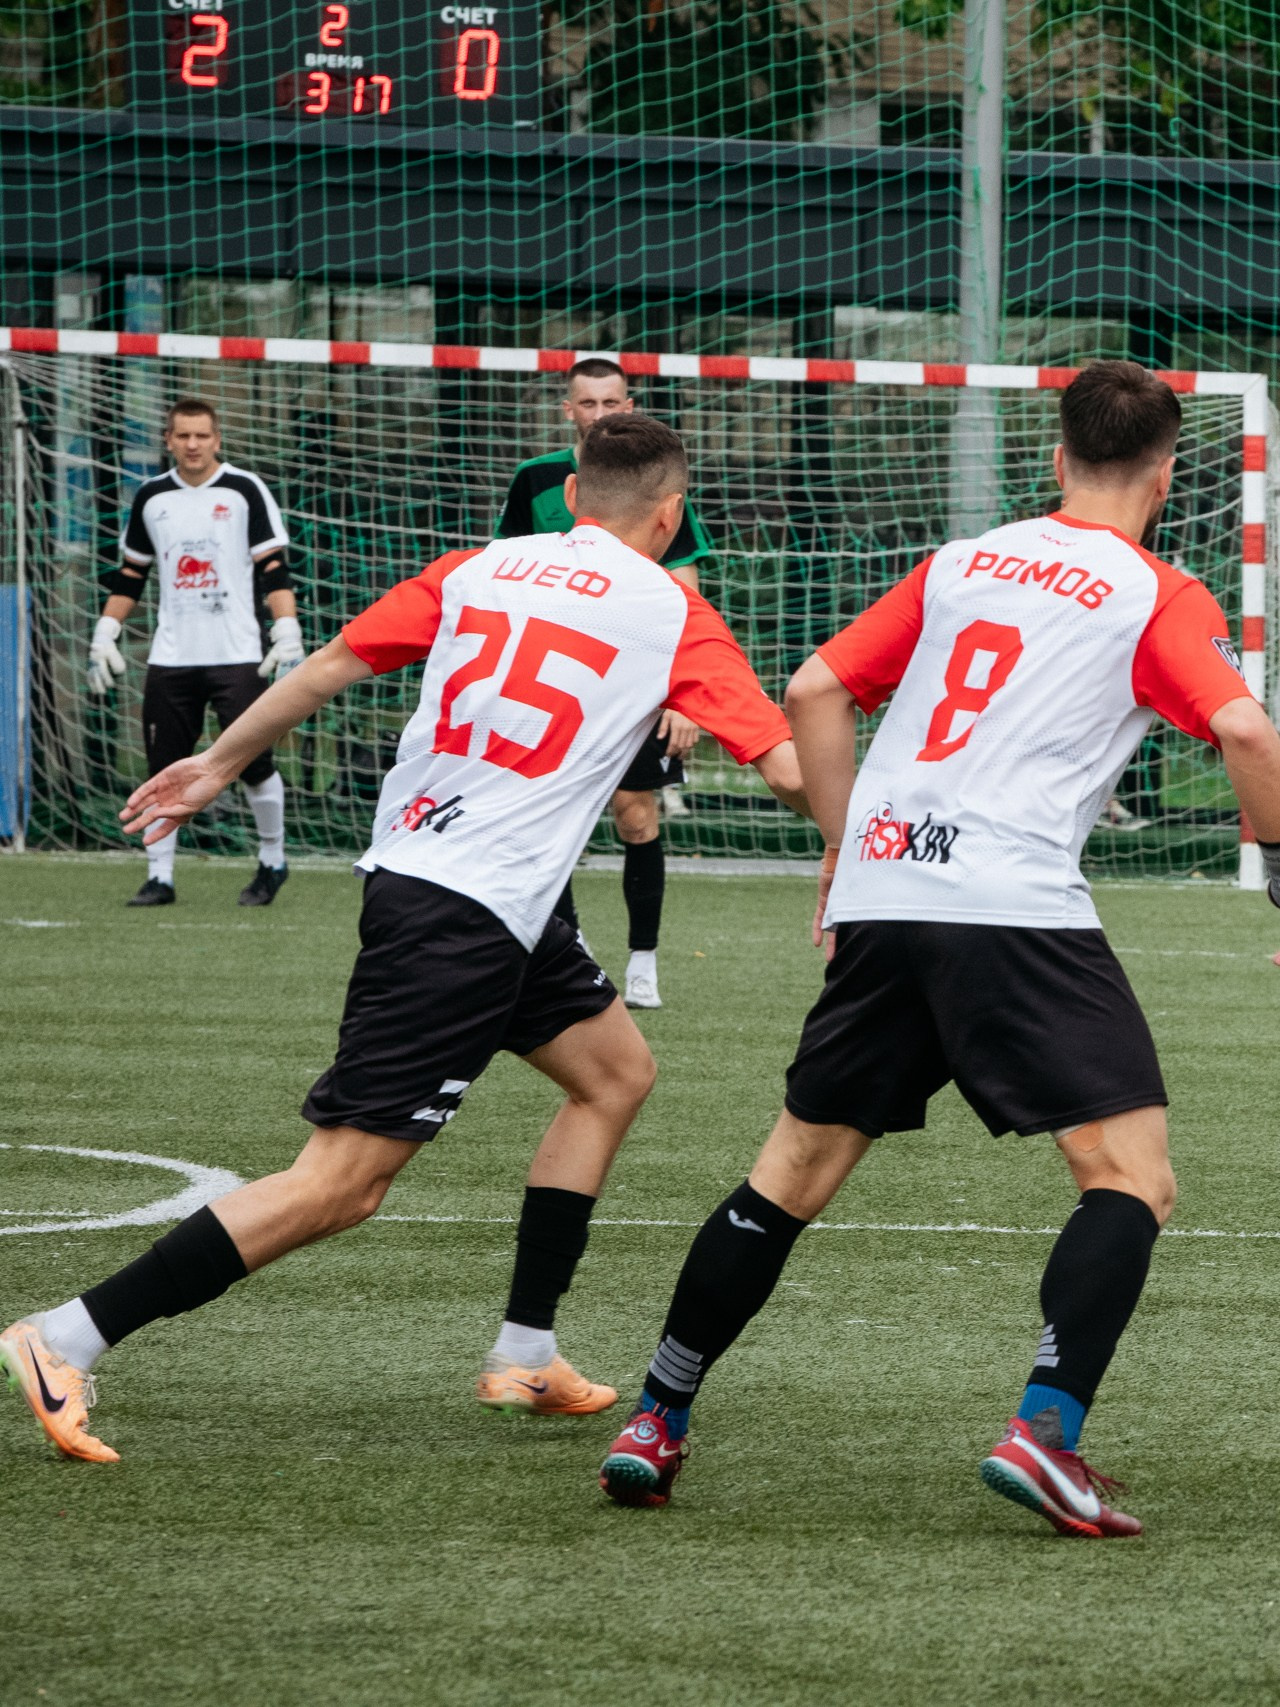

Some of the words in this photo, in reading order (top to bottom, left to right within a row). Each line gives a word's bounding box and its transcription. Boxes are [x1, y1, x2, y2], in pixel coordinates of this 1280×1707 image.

[320, 4, 348, 47] 2
[441, 6, 498, 25] СЧЕТ
[182, 15, 229, 86] 2
[305, 53, 364, 69] ВРЕМЯ
[454, 29, 500, 99] 0
[492, 557, 612, 598] ШЕФ
[964, 550, 1114, 610] РОМОВ
[432, 606, 620, 780] 25
[916, 619, 1025, 763] 8
